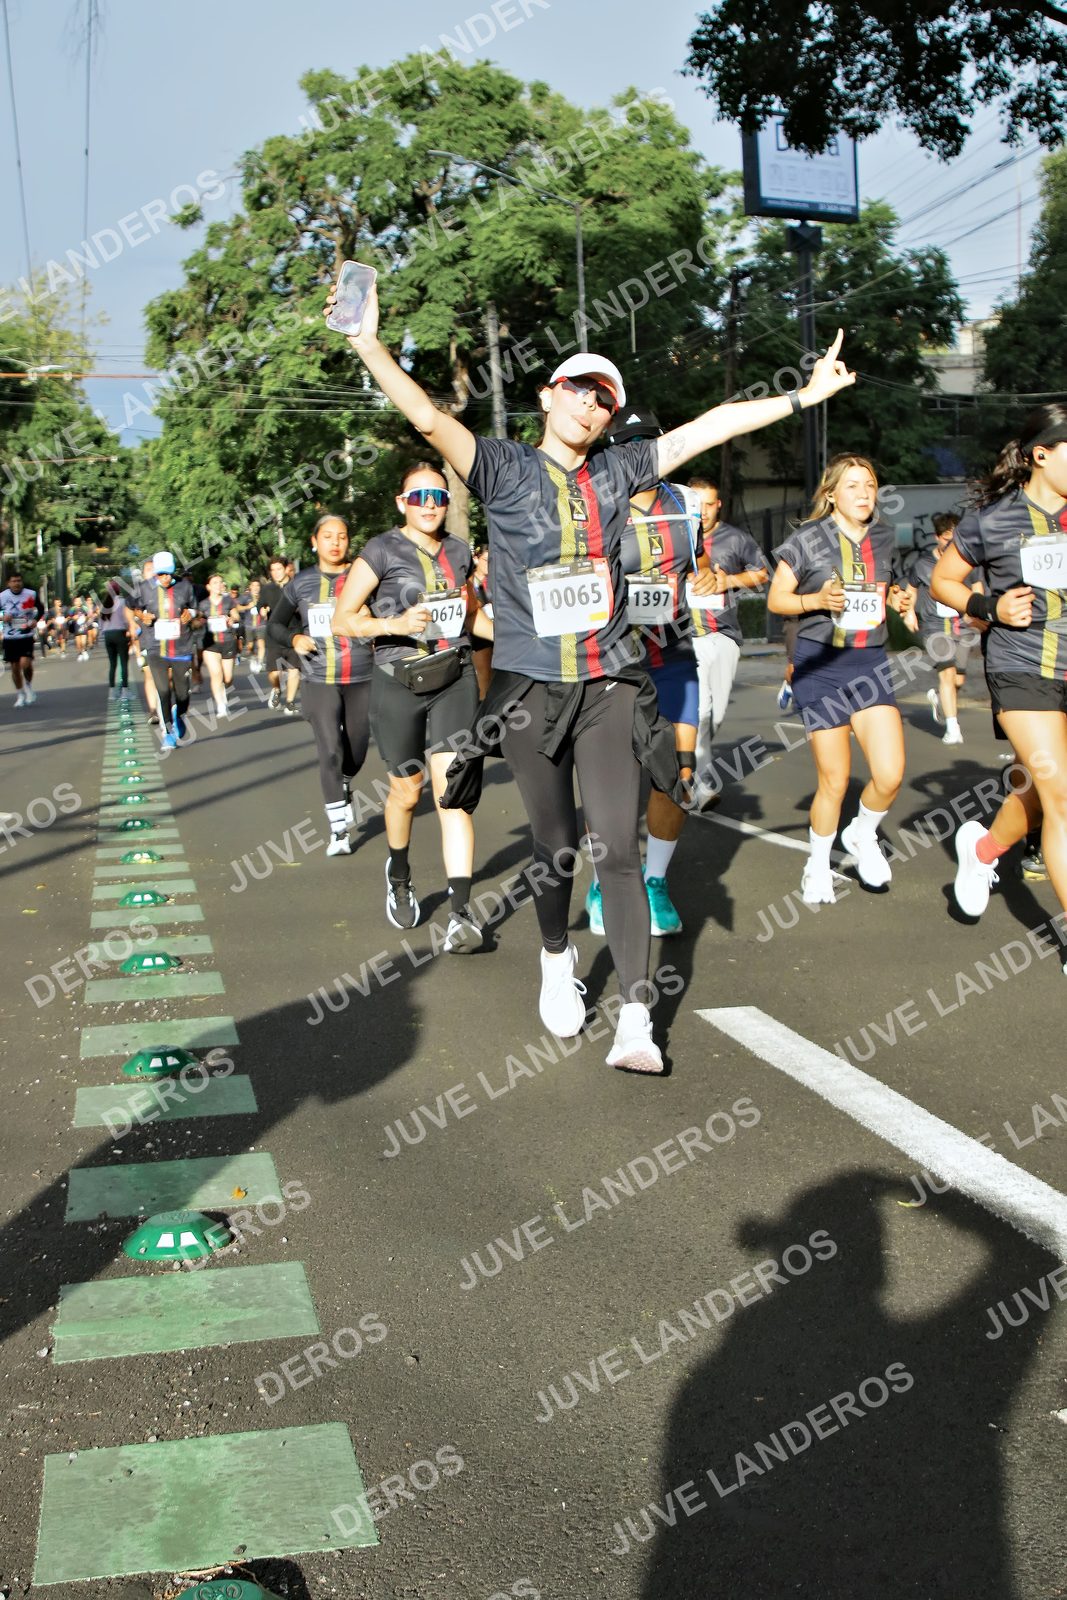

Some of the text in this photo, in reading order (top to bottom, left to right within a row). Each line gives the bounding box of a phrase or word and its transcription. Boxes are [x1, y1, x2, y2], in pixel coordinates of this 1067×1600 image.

[1032, 552, 1064, 571] 897
[536, 582, 602, 612] 10065
[633, 590, 670, 607] 1397
[844, 598, 877, 613] 2465
[431, 603, 463, 623] 0674
